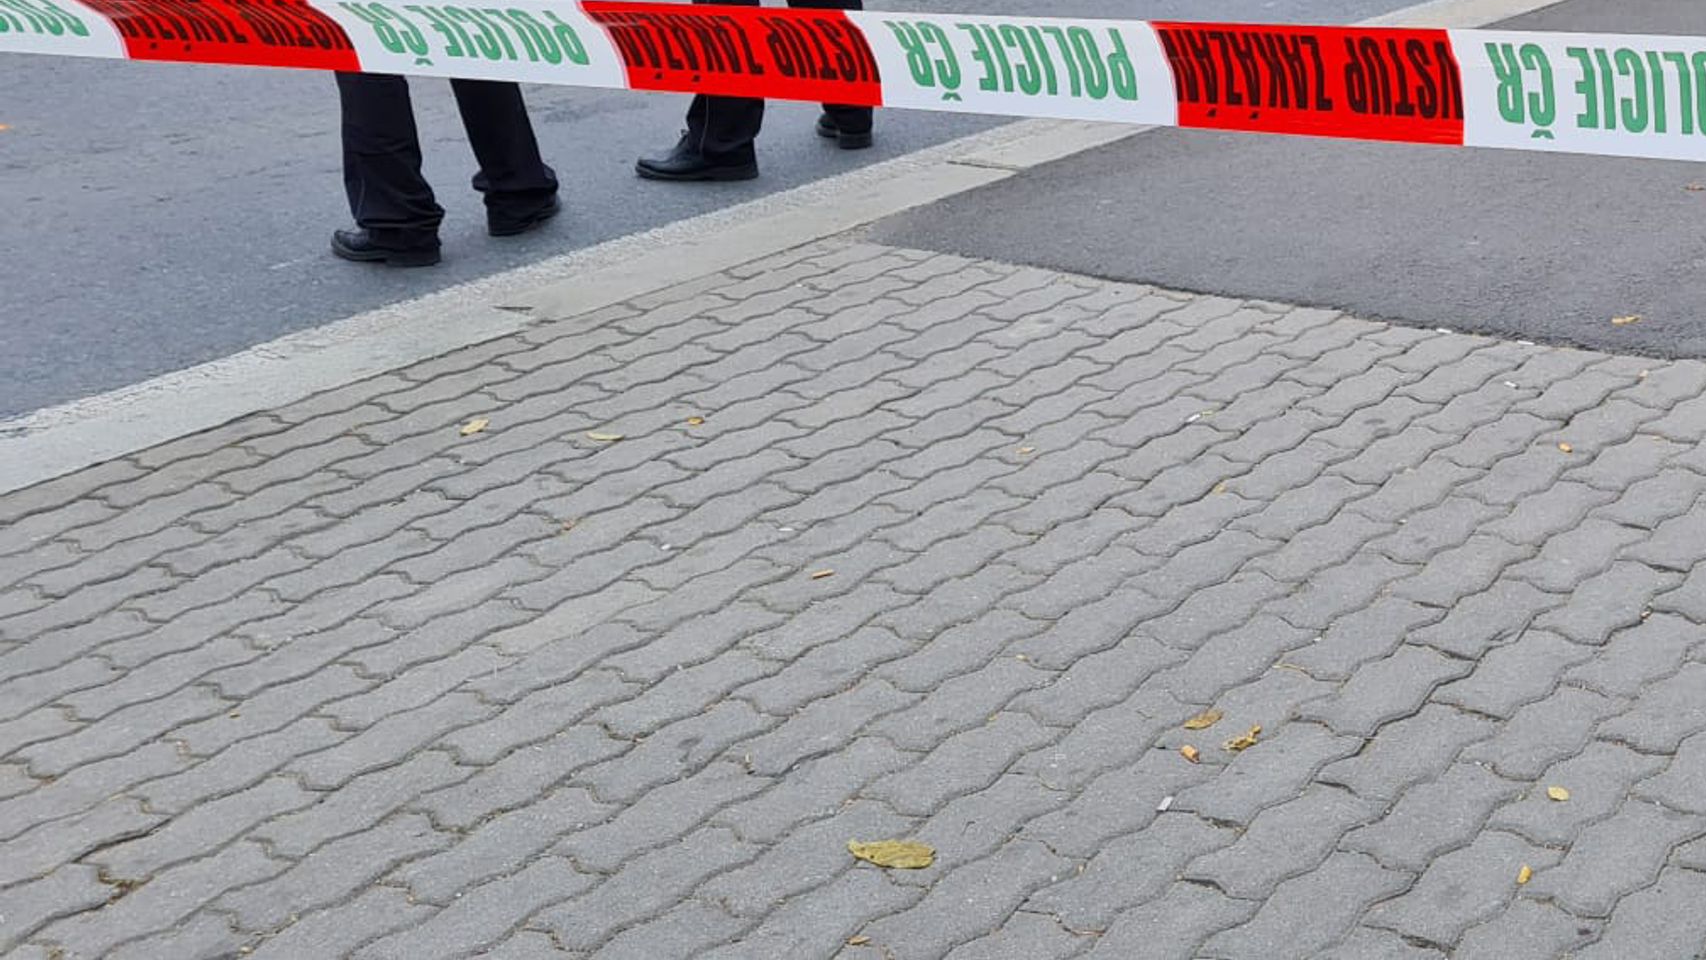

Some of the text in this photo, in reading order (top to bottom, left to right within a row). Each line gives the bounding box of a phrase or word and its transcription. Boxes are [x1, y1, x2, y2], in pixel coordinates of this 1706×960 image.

[338, 1, 591, 66] POLICIE ČR
[590, 11, 882, 83] VSTUP ZAKÁZÁN
[882, 20, 1139, 102] POLICIE ČR
[1156, 28, 1464, 120] VSTUP ZAKÁZÁN
[1485, 41, 1557, 139] ČR
